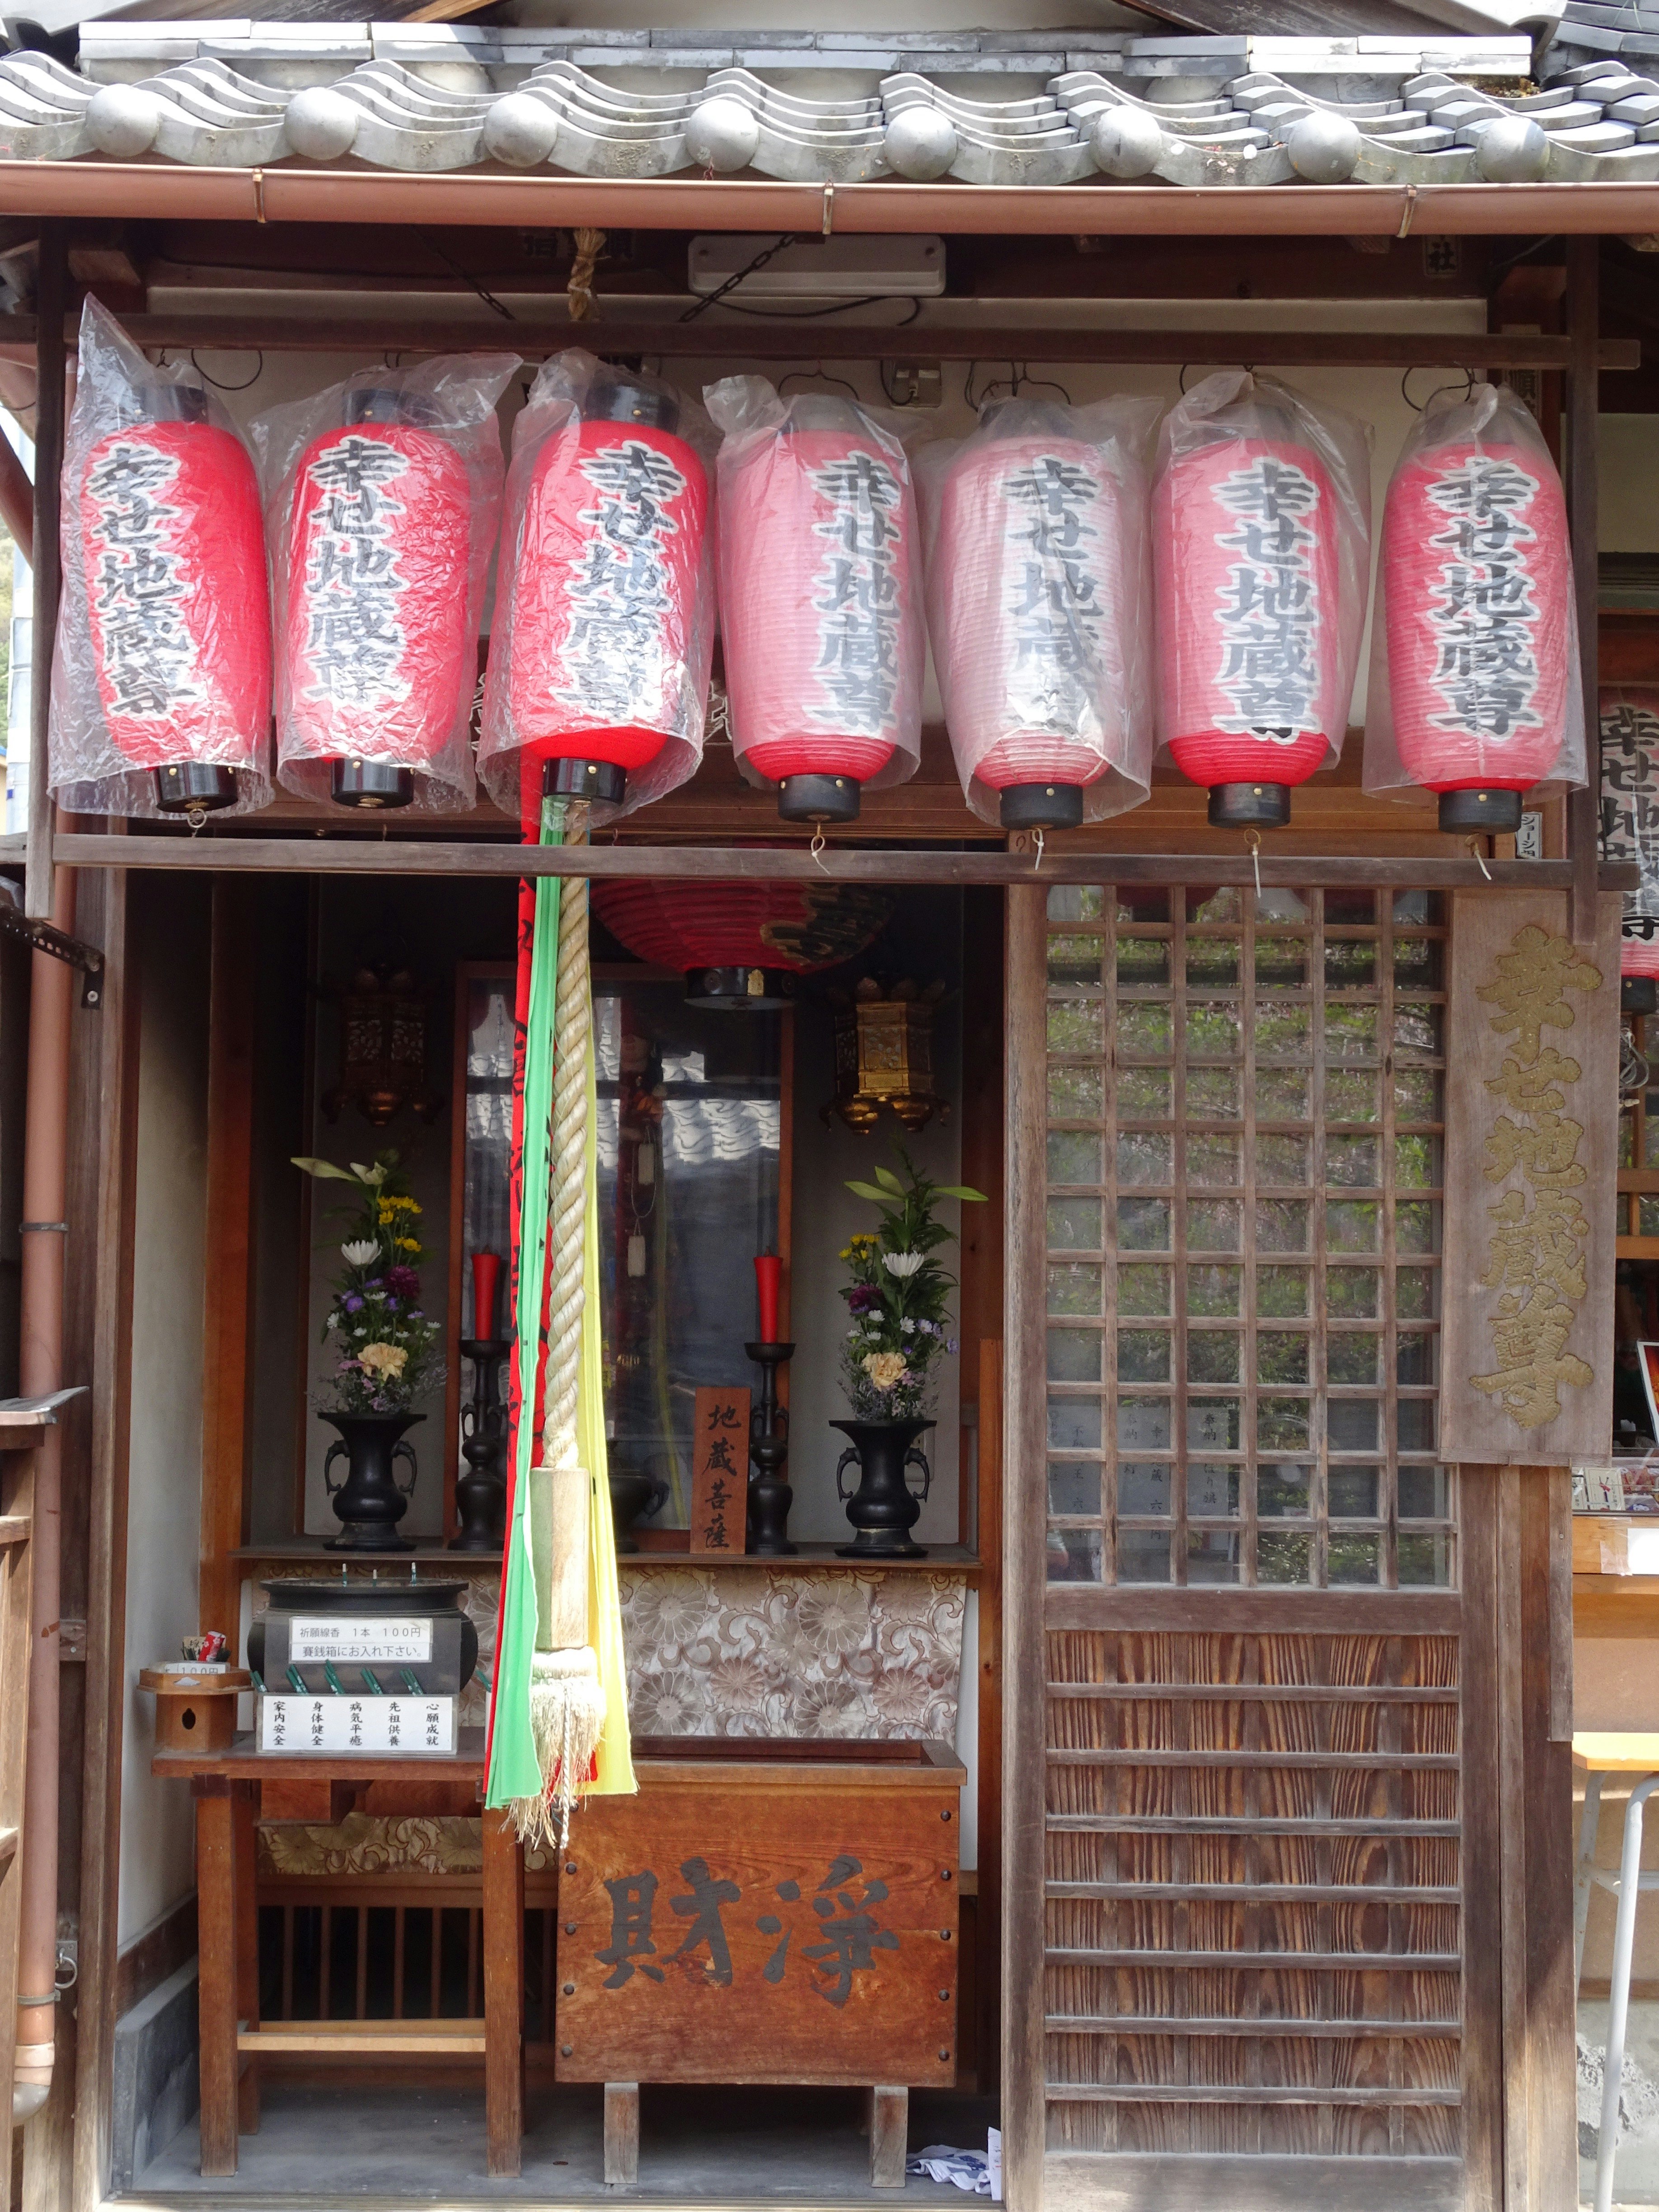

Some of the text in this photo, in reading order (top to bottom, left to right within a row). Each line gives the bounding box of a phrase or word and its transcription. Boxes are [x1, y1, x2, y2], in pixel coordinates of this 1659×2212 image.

[804, 453, 900, 734] 幸せ地蔵尊
[1212, 459, 1320, 741] 幸せ地蔵尊
[1426, 458, 1541, 736] 幸せ地蔵尊
[300, 1627, 421, 1637] 祈願線香 1本 100円
[303, 1646, 422, 1658] 賽銭箱にお入れ下さい。
[273, 1701, 286, 1746] 家内安全
[311, 1701, 324, 1746] 身体健全
[349, 1701, 363, 1746] 病気平癒
[388, 1701, 401, 1746] 先祖供養
[426, 1703, 439, 1745] 心願成就
